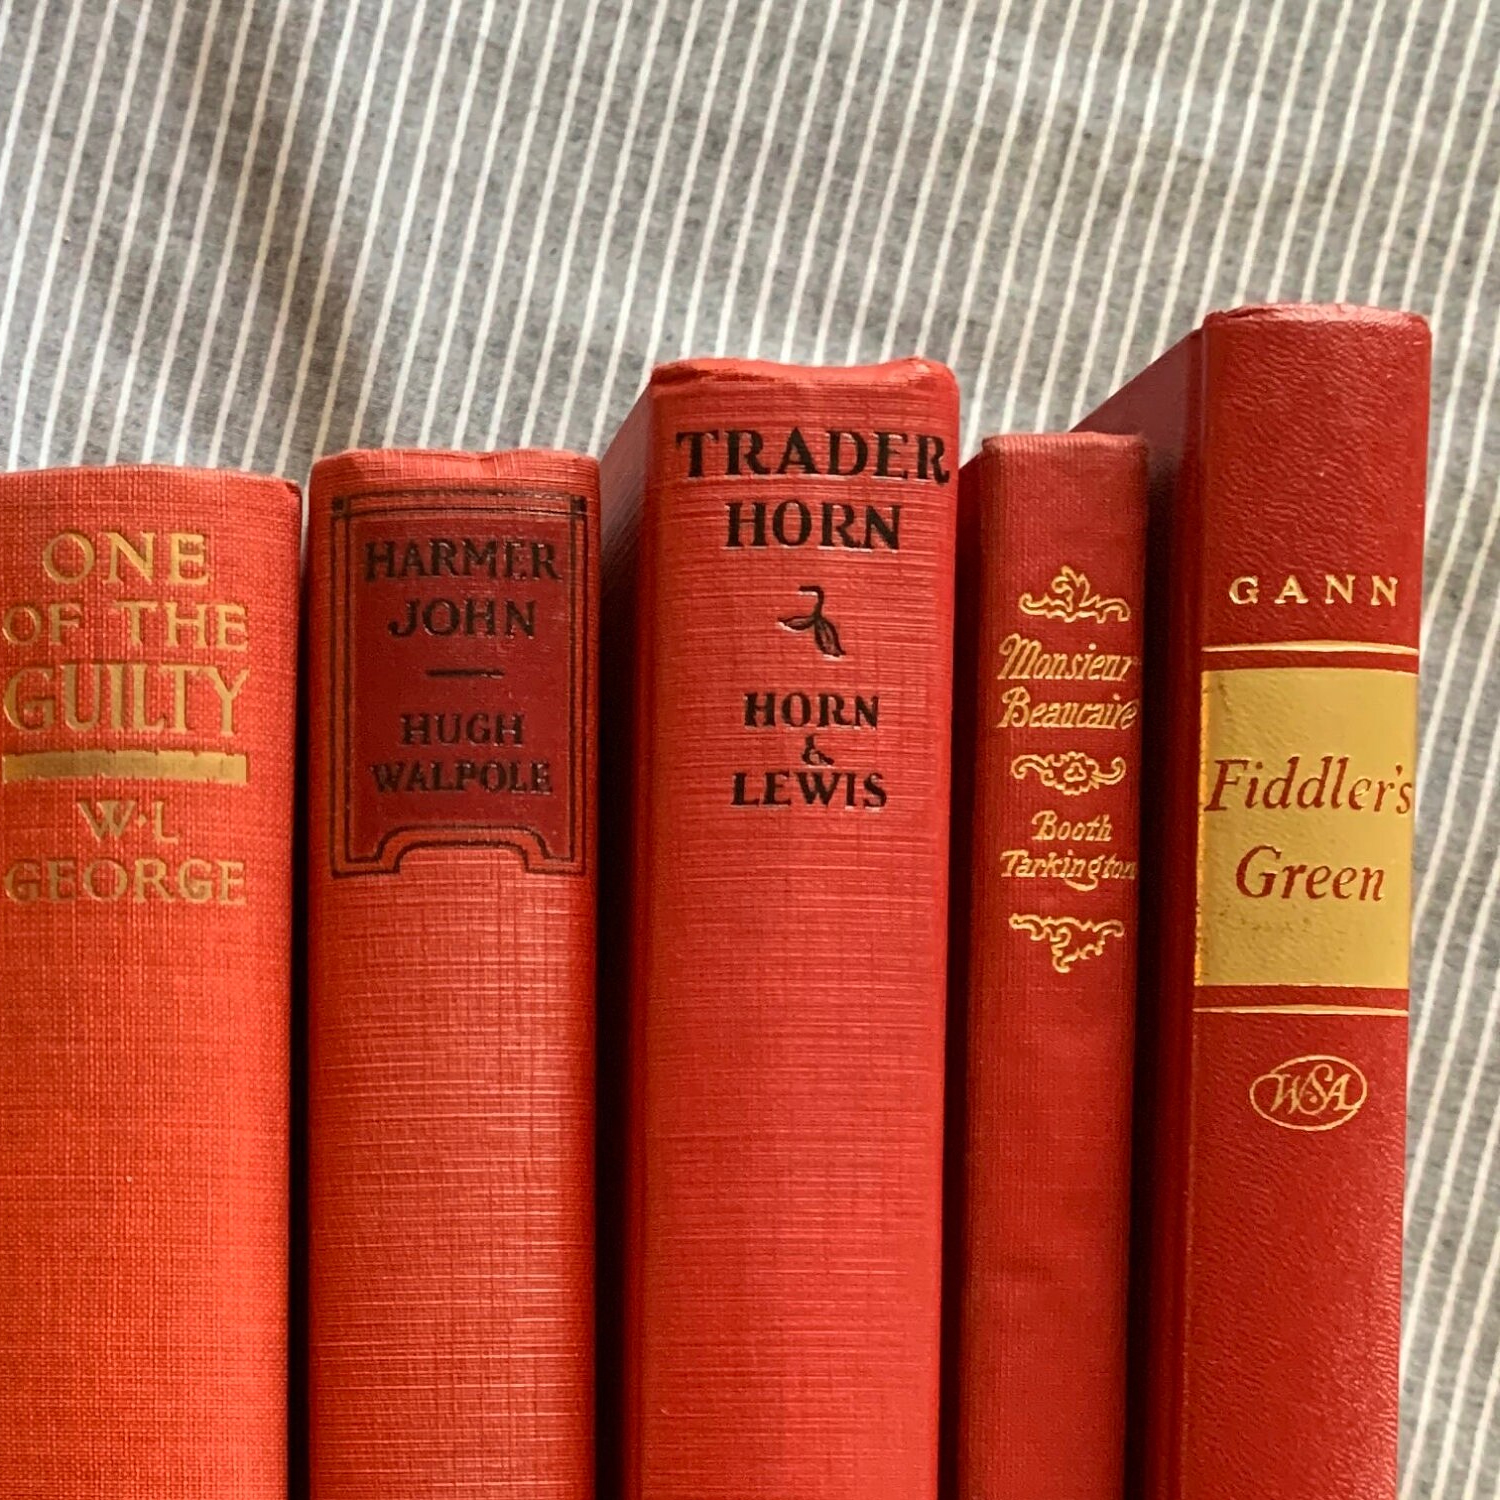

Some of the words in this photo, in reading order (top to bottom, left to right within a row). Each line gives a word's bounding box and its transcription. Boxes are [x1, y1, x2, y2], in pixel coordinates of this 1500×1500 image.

[676, 428, 951, 484] TRADER
[722, 502, 902, 551] HORN
[42, 531, 209, 585] ONE
[363, 538, 563, 582] HARMER
[1228, 575, 1398, 607] GANN
[2, 604, 80, 647] OF
[111, 602, 250, 652] THE
[389, 599, 537, 640] JOHN
[997, 633, 1136, 681] Monsieur
[2, 663, 251, 737] GUILTY
[743, 692, 880, 729] HORN
[997, 686, 1138, 731] Beaucaire
[400, 713, 525, 747] HUGH
[800, 734, 834, 767] &
[372, 761, 554, 796] WALPOLE
[731, 770, 888, 810] LEWIS
[1204, 756, 1413, 814] Fiddler's
[1031, 810, 1113, 843] Booth
[4, 857, 248, 905] GEORGE
[1000, 850, 1137, 892] Tarkington
[1235, 845, 1386, 902] Green
